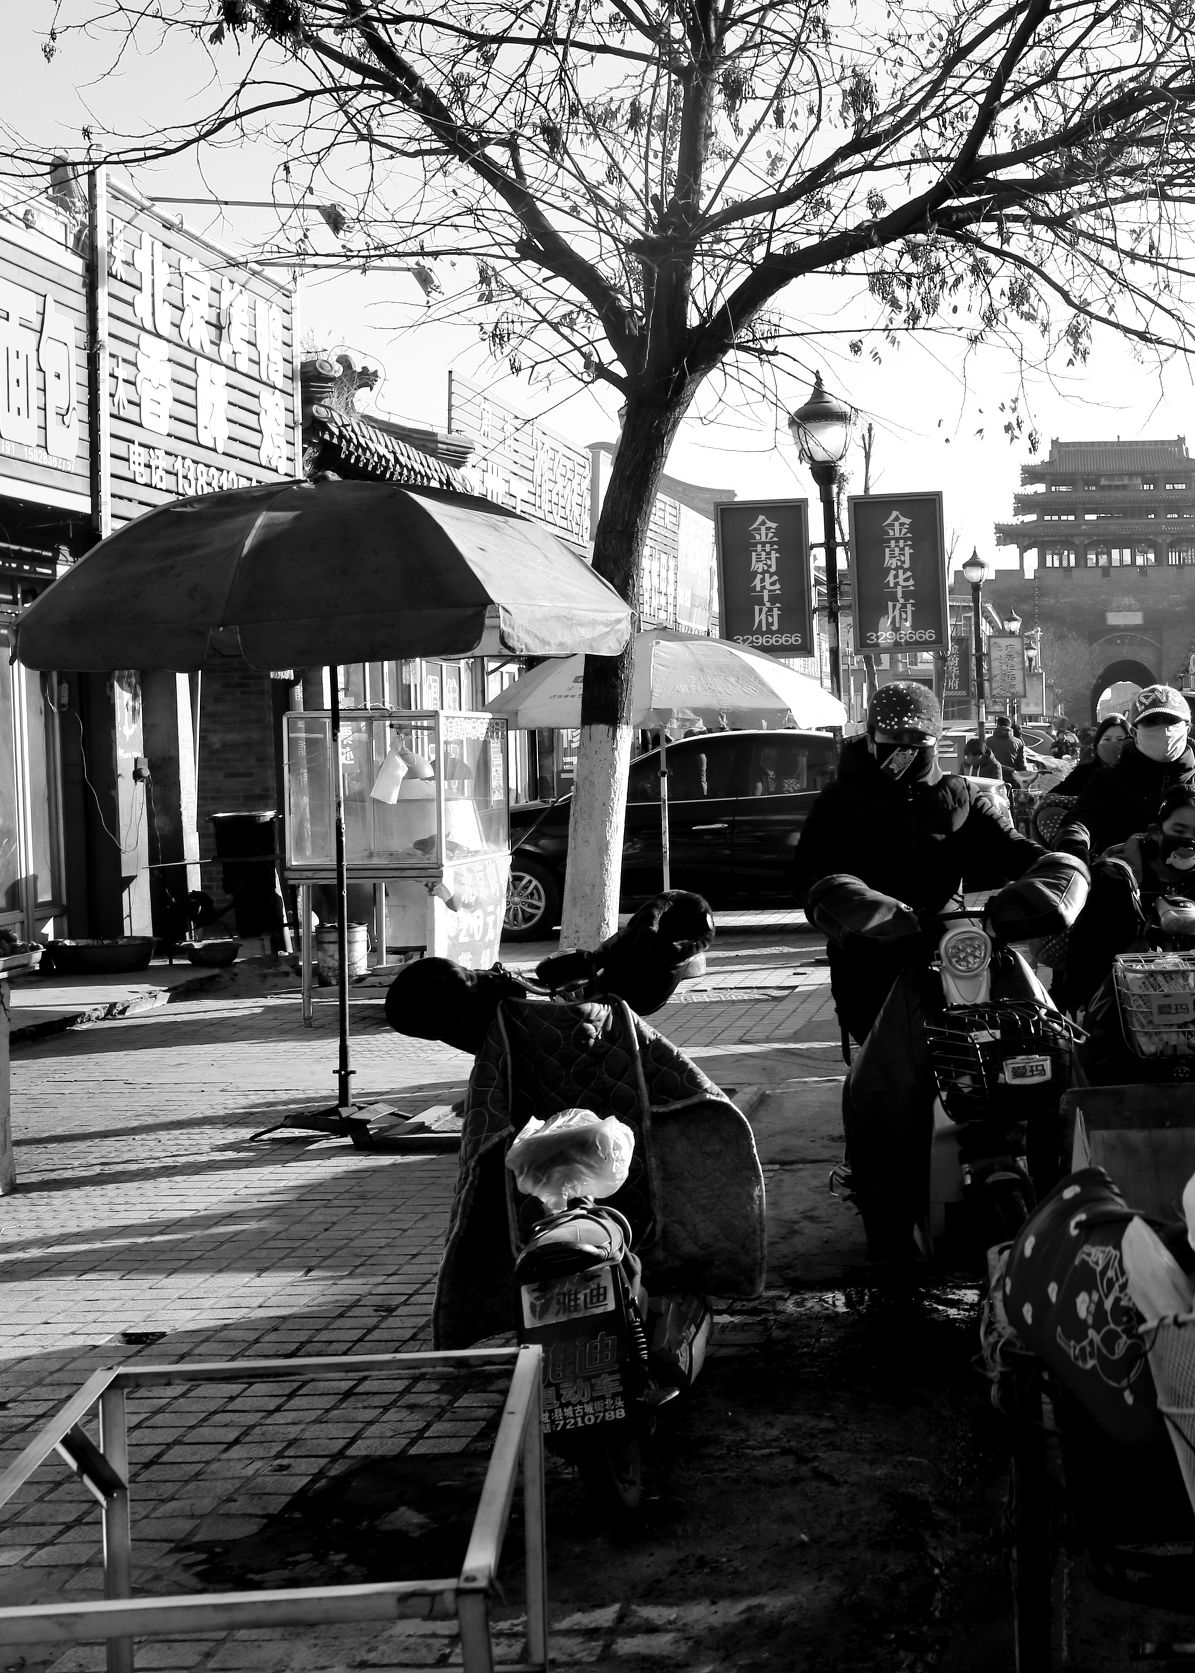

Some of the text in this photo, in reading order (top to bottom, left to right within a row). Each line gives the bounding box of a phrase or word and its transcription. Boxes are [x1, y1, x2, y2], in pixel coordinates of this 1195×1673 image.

[129, 440, 167, 490] 电话
[748, 514, 782, 632] 金蔚华府
[881, 510, 916, 628] 金蔚华府
[733, 632, 802, 648] 3296666
[866, 629, 936, 644] 3296666
[555, 1283, 608, 1318] 雅迪
